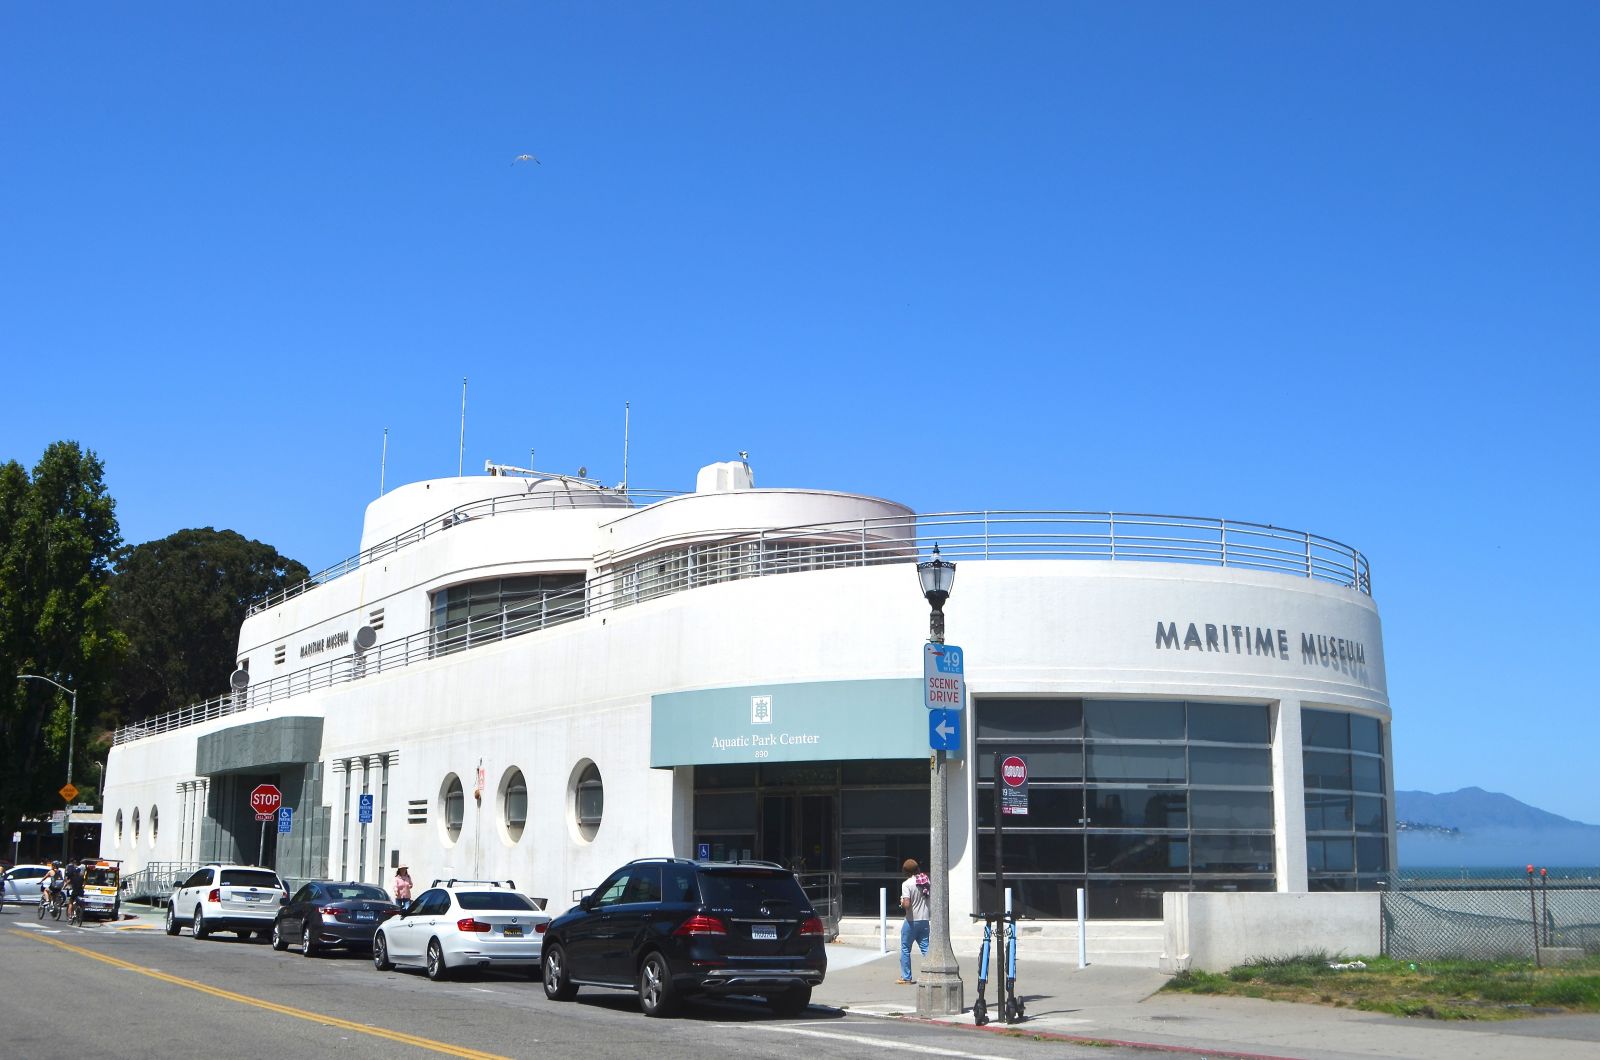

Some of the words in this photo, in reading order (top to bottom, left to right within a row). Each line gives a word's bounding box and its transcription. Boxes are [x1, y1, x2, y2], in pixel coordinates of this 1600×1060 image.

[300, 639, 324, 658] MARITIME
[326, 630, 349, 649] MUSEUM
[1155, 621, 1289, 659] MARITIME
[1301, 632, 1366, 665] MUSEUM
[943, 651, 960, 667] 49
[929, 677, 959, 690] SCENIC
[930, 691, 960, 703] DRIVE
[712, 736, 749, 750] Aquatic
[752, 734, 777, 746] Park
[779, 733, 820, 745] Center
[1002, 788, 1008, 796] 19
[253, 794, 280, 805] STOP
